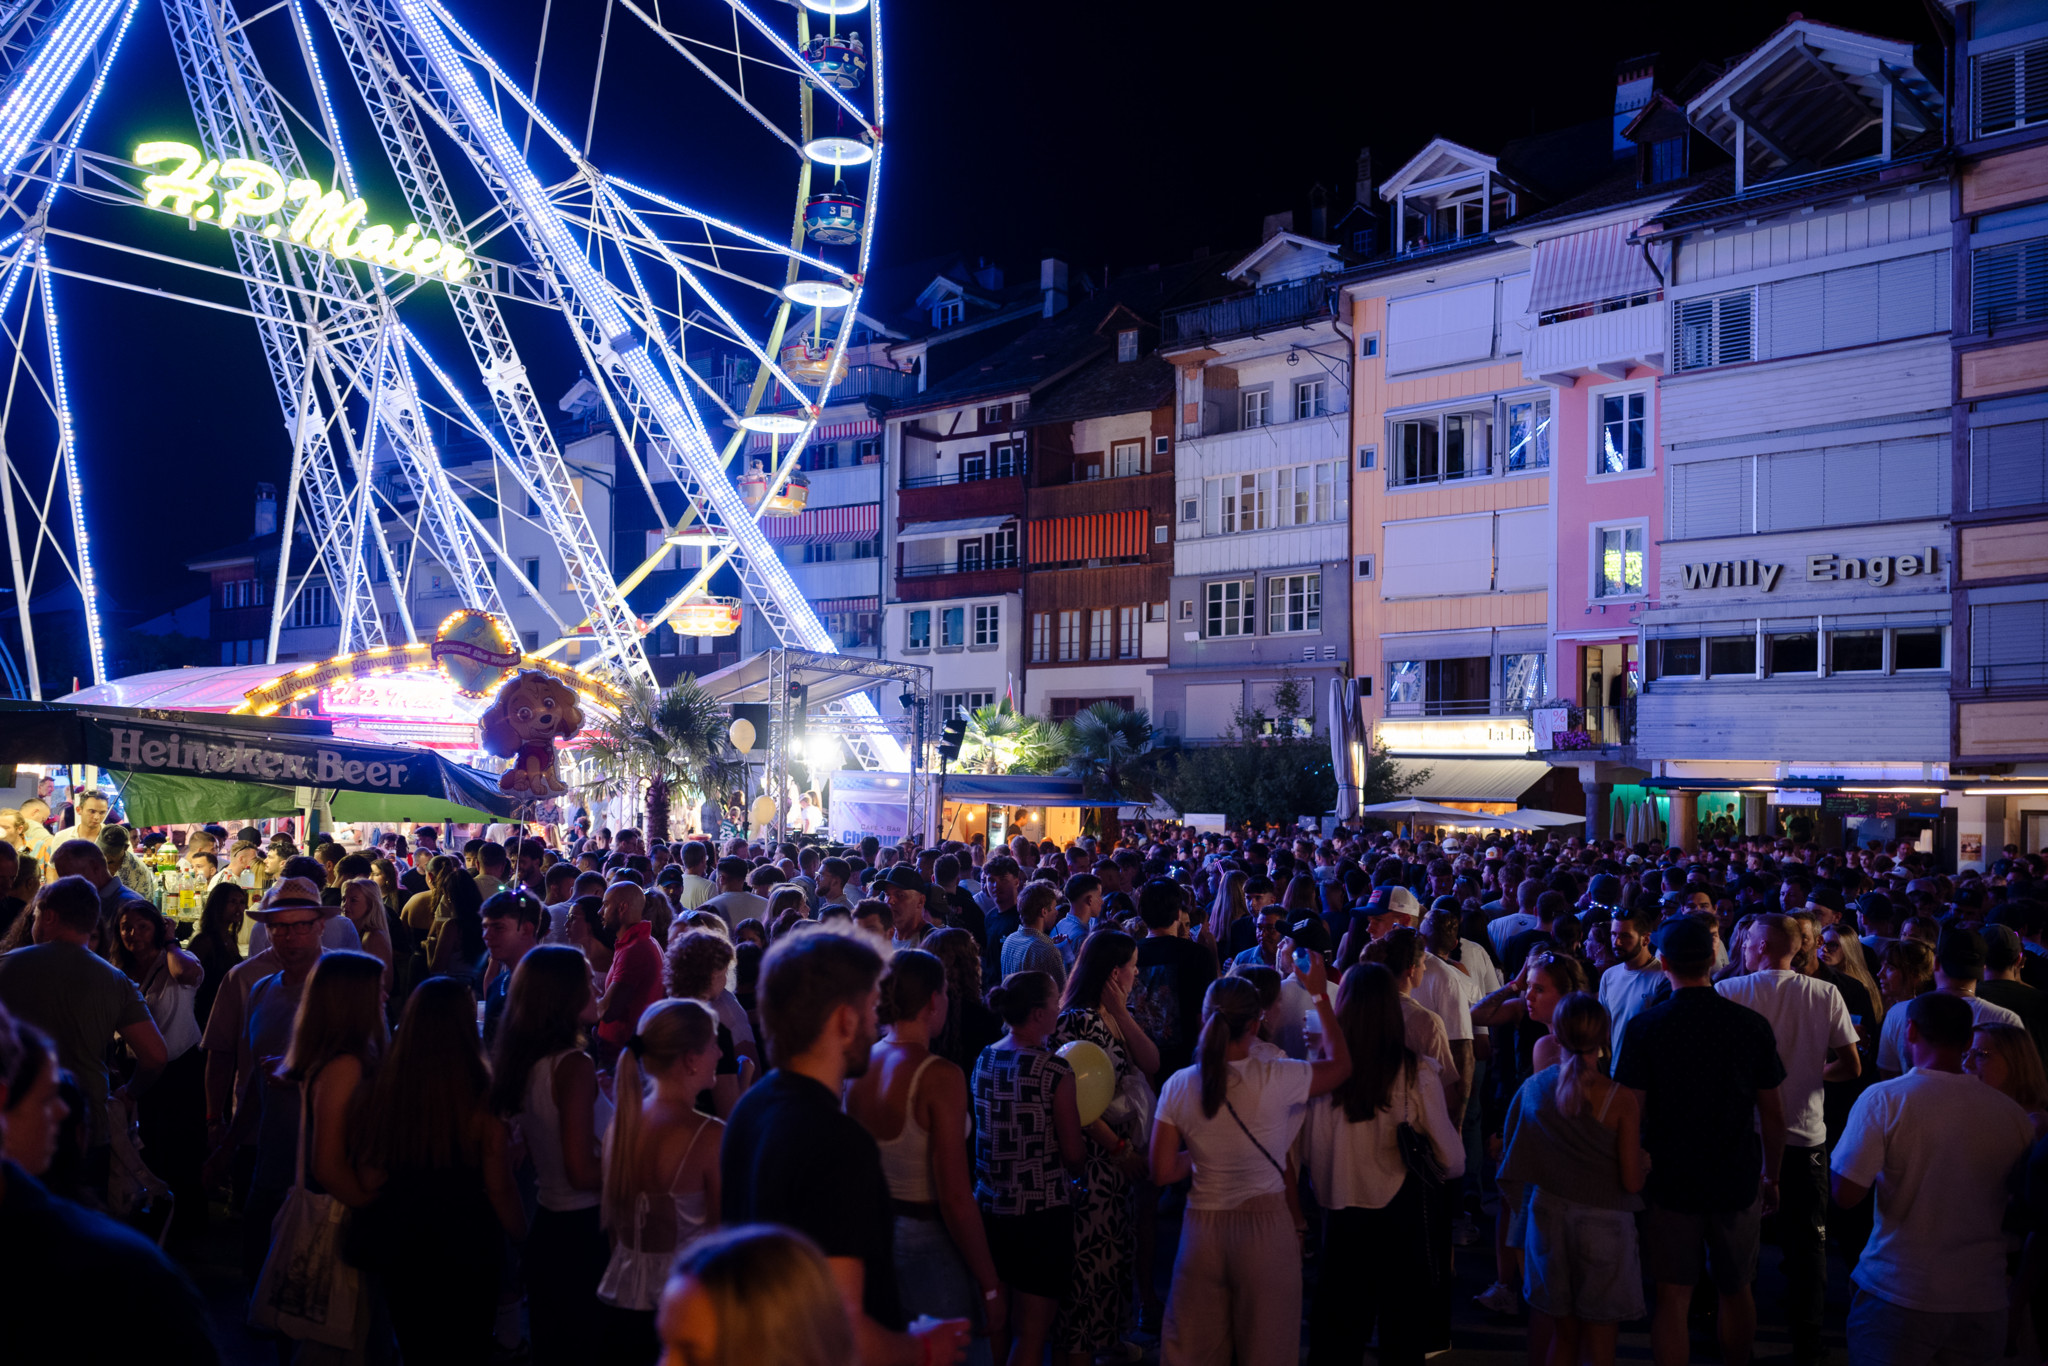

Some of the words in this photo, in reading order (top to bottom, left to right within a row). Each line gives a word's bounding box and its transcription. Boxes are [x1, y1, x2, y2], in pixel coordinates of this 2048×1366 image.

[1679, 559, 1783, 592] Willy
[1806, 546, 1938, 587] Engel
[262, 666, 341, 703] Willkommen
[351, 652, 413, 673] Benvenuti
[109, 728, 309, 780] Heineken
[315, 750, 409, 788] Beer
